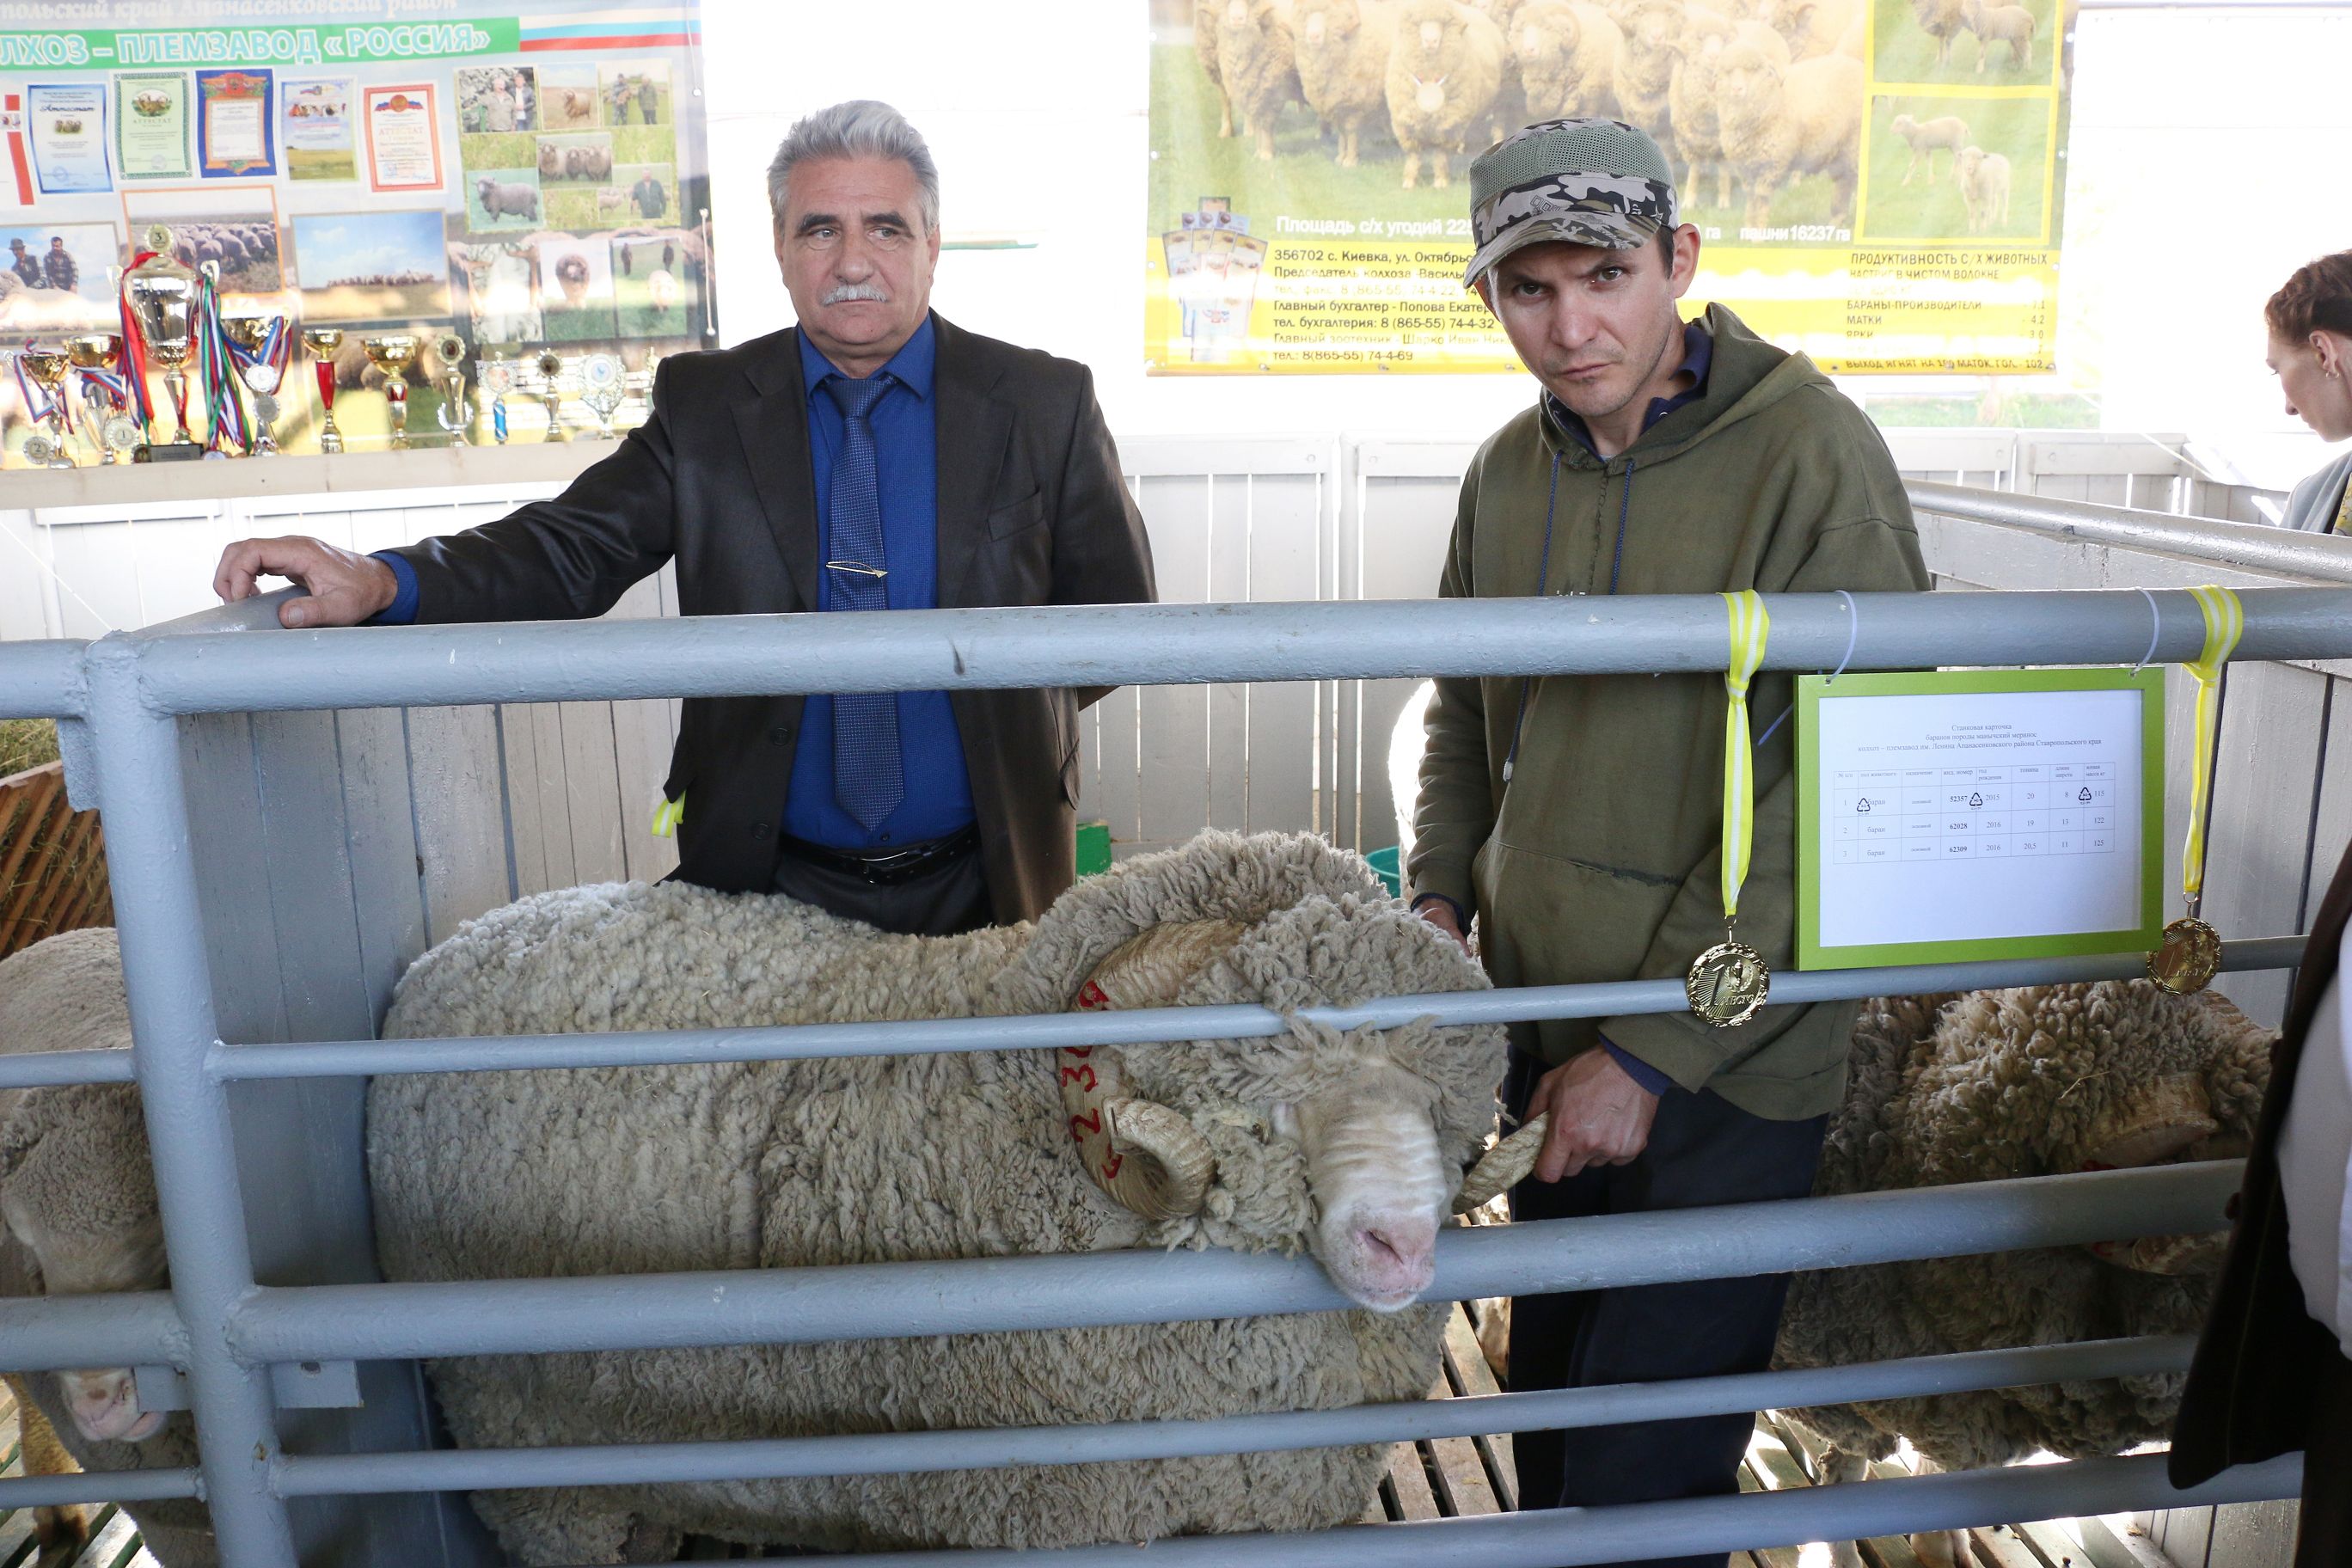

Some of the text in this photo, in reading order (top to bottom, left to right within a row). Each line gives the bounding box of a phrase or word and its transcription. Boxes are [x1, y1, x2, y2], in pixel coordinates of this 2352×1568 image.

[0, 34, 89, 66] ЛХОЗ
[116, 29, 322, 65] ПЛЕМЗАВОД
[1277, 216, 1356, 236] Площадь
[1359, 217, 1383, 234] с/х
[1387, 219, 1442, 237] угодий
[1740, 227, 1788, 241] пашни
[1791, 224, 1835, 241] 16237
[1274, 250, 1323, 260] 356702
[1342, 251, 1391, 263] Киевка,
[1396, 254, 1410, 264] ул.
[1851, 254, 1957, 266] ПРОДУКТИВНОСТЬ
[1986, 254, 2048, 265] ЖИВОТНЫХ
[1274, 266, 1359, 279] Председатель
[1364, 269, 1411, 279] колхоза
[1896, 271, 1903, 279] В
[1907, 270, 1951, 279] ЧИСТОМ
[1954, 270, 1999, 279] ВОЛОКНЕ
[1274, 301, 1326, 310] Главный
[1330, 300, 1389, 313] бухгалтер
[1400, 302, 1444, 312] Попова
[1847, 300, 1981, 310] БАРАНЫ-ПРОИЗВОДИТЕЛИ
[1274, 316, 1494, 330] тел. бухгалтерия: 8 (865-55) 74-4-32
[1847, 315, 1882, 325] МАТКИ
[1274, 333, 1325, 344] Главный
[1302, 351, 1363, 361] 8(865-55)
[1369, 351, 1413, 361] 74-4-69
[2025, 359, 2043, 369] 102
[2036, 738, 2086, 747] Ставропольского
